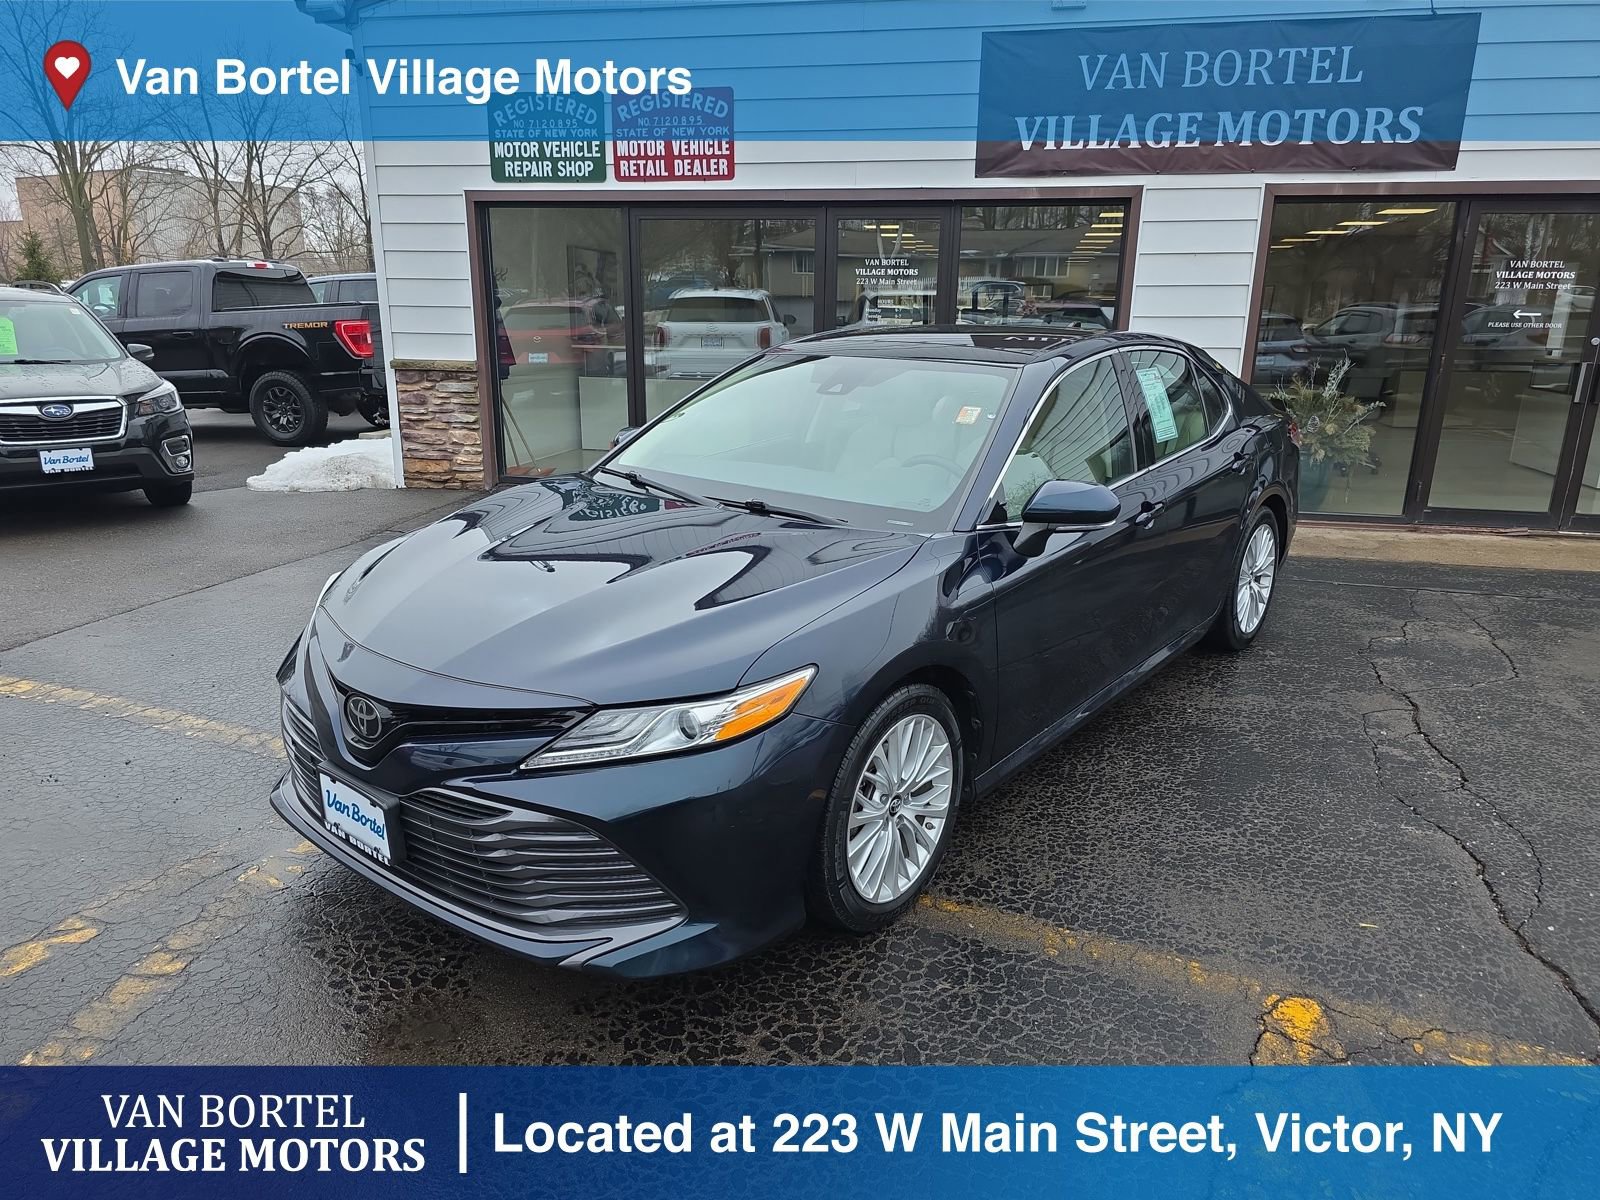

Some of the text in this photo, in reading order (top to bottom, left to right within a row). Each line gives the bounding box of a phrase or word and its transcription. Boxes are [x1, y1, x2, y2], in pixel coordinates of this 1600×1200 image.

[1078, 46, 1363, 91] VAN BORTEL
[493, 95, 598, 127] REGISTERED
[617, 91, 729, 122] REGISTERED
[529, 118, 578, 128] 7120895
[653, 115, 703, 126] 7120895
[494, 128, 598, 138] STATE OF NEW YORK
[616, 126, 730, 138] STATE OF NEW YORK
[1015, 106, 1424, 151] VILLAGE MOTORS
[494, 141, 600, 158] MOTOR VEHICLE
[616, 140, 730, 157] MOTOR VEHICLE
[505, 161, 594, 177] REPAIR SHOP
[619, 159, 728, 177] RETAIL DEALER
[865, 258, 909, 266] VAN BORTEL
[1510, 260, 1565, 268] VAN BORTEL
[855, 268, 919, 276] VILLAGE MOTORS
[1496, 271, 1576, 279] VILLAGE MOTORS
[856, 277, 918, 285] 223 W Main Street
[1494, 281, 1571, 290] 223 W Main Street
[282, 321, 328, 329] TREMOR
[43, 454, 90, 465] Van Bortel
[325, 789, 386, 841] Van Bortel
